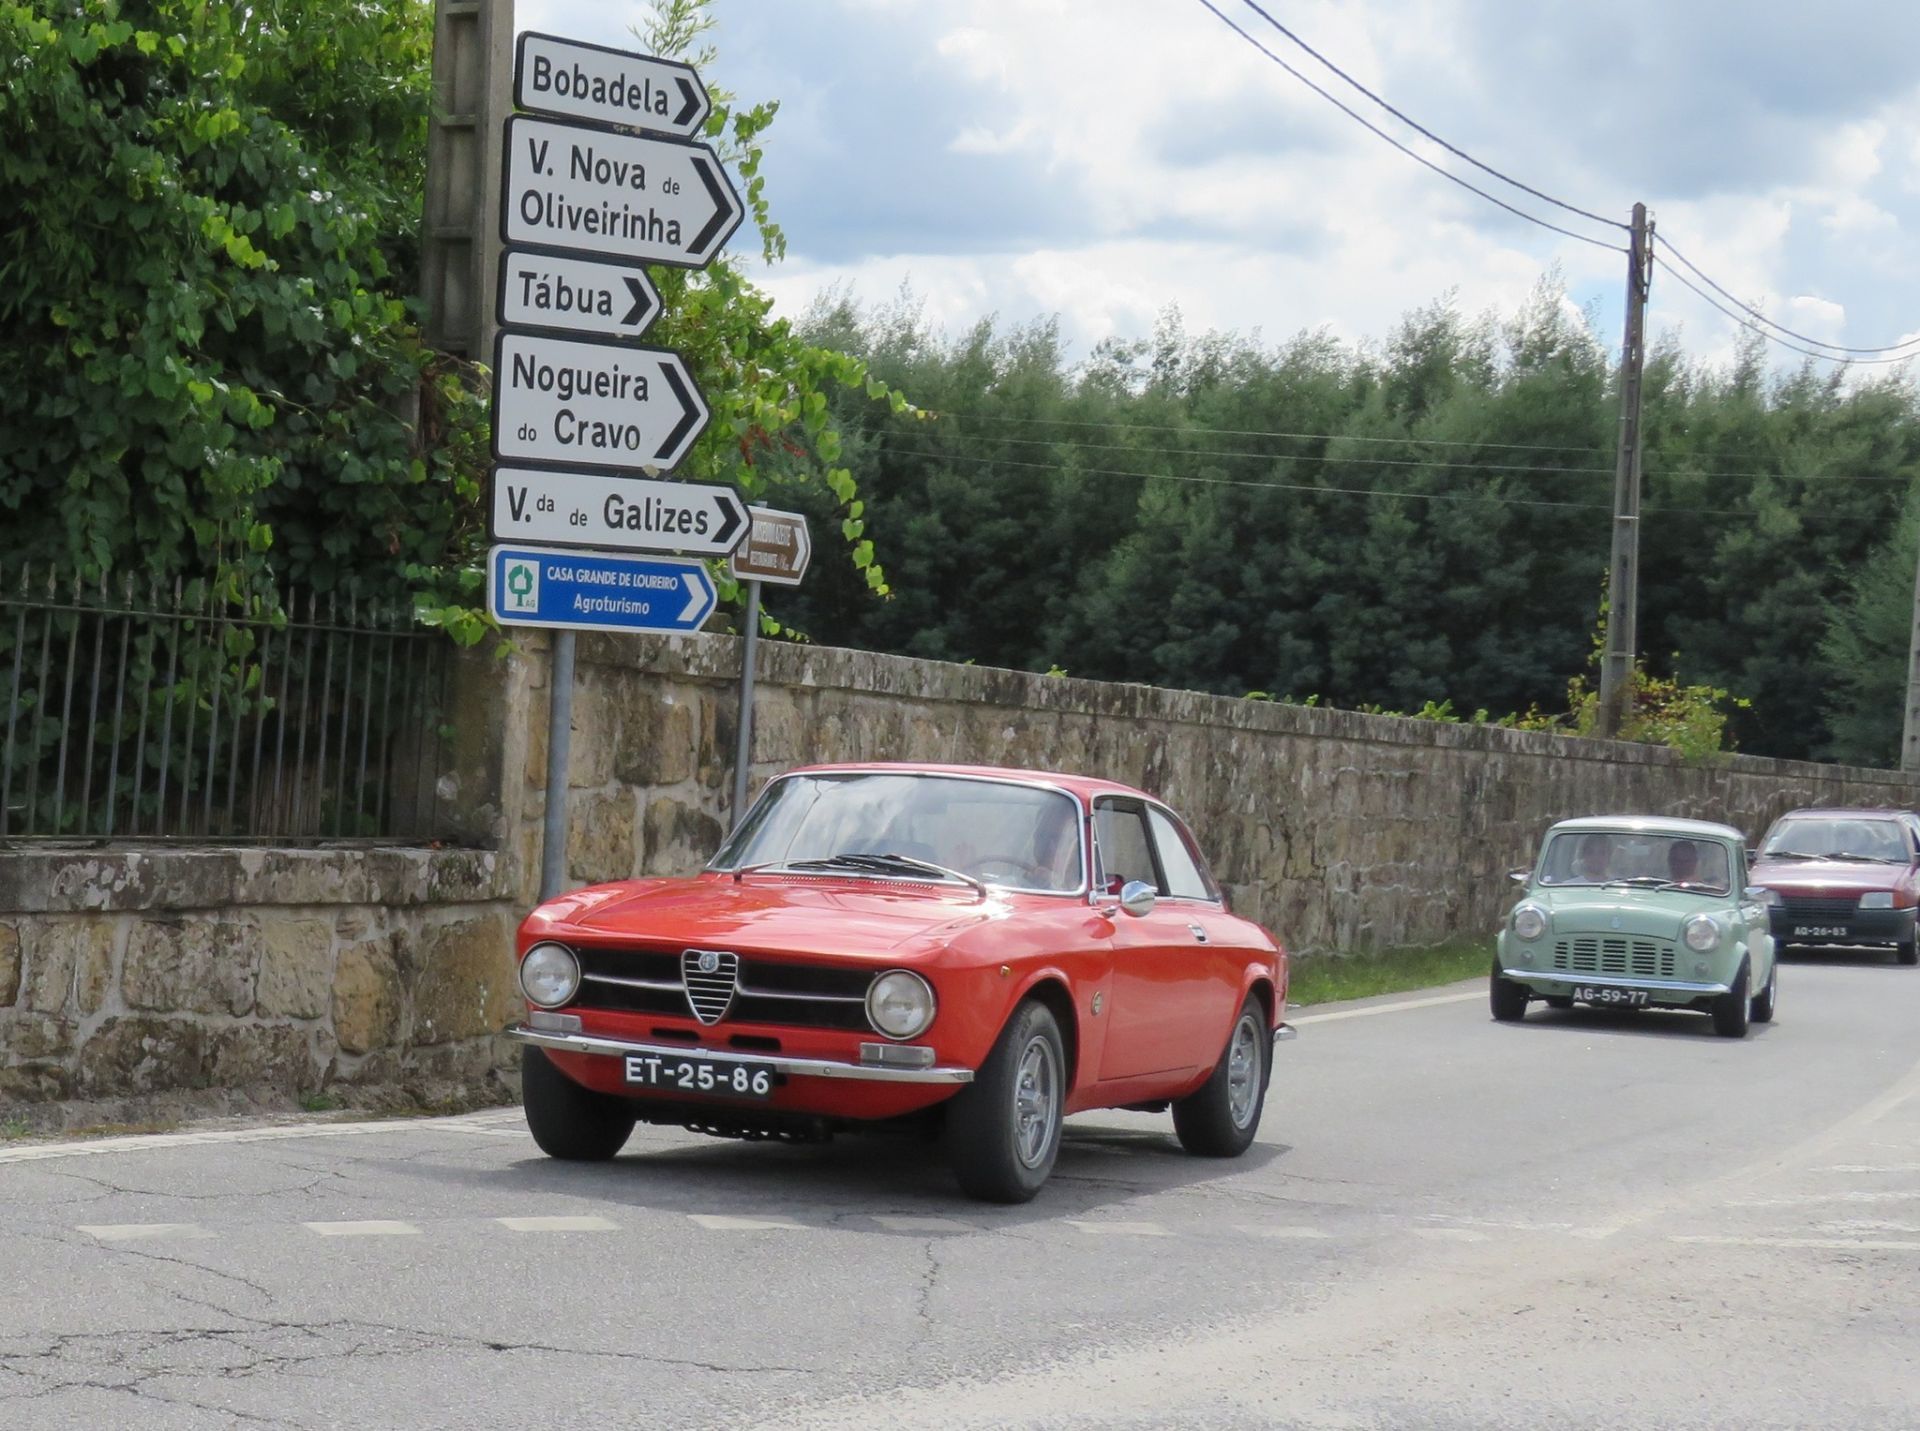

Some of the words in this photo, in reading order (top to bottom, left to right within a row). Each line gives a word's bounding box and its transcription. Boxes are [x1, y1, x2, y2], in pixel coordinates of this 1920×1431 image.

[532, 55, 669, 117] Bobadela
[528, 137, 554, 177] V.
[570, 144, 646, 191] Nova
[662, 176, 681, 196] de
[520, 189, 682, 246] Oliveirinha
[518, 270, 613, 316] Tábua
[512, 353, 649, 402] Nogueira
[517, 423, 537, 442] do
[554, 408, 641, 451] Cravo
[569, 508, 588, 527] de
[603, 493, 709, 535] Galizes
[547, 566, 574, 582] CASA
[576, 568, 616, 585] GRANDE
[618, 573, 631, 586] DE
[633, 574, 678, 591] LOUREIRO
[573, 593, 650, 615] Agroturismo
[1573, 987, 1648, 1004] AG-59-77
[625, 1056, 769, 1095] ET-25-86
